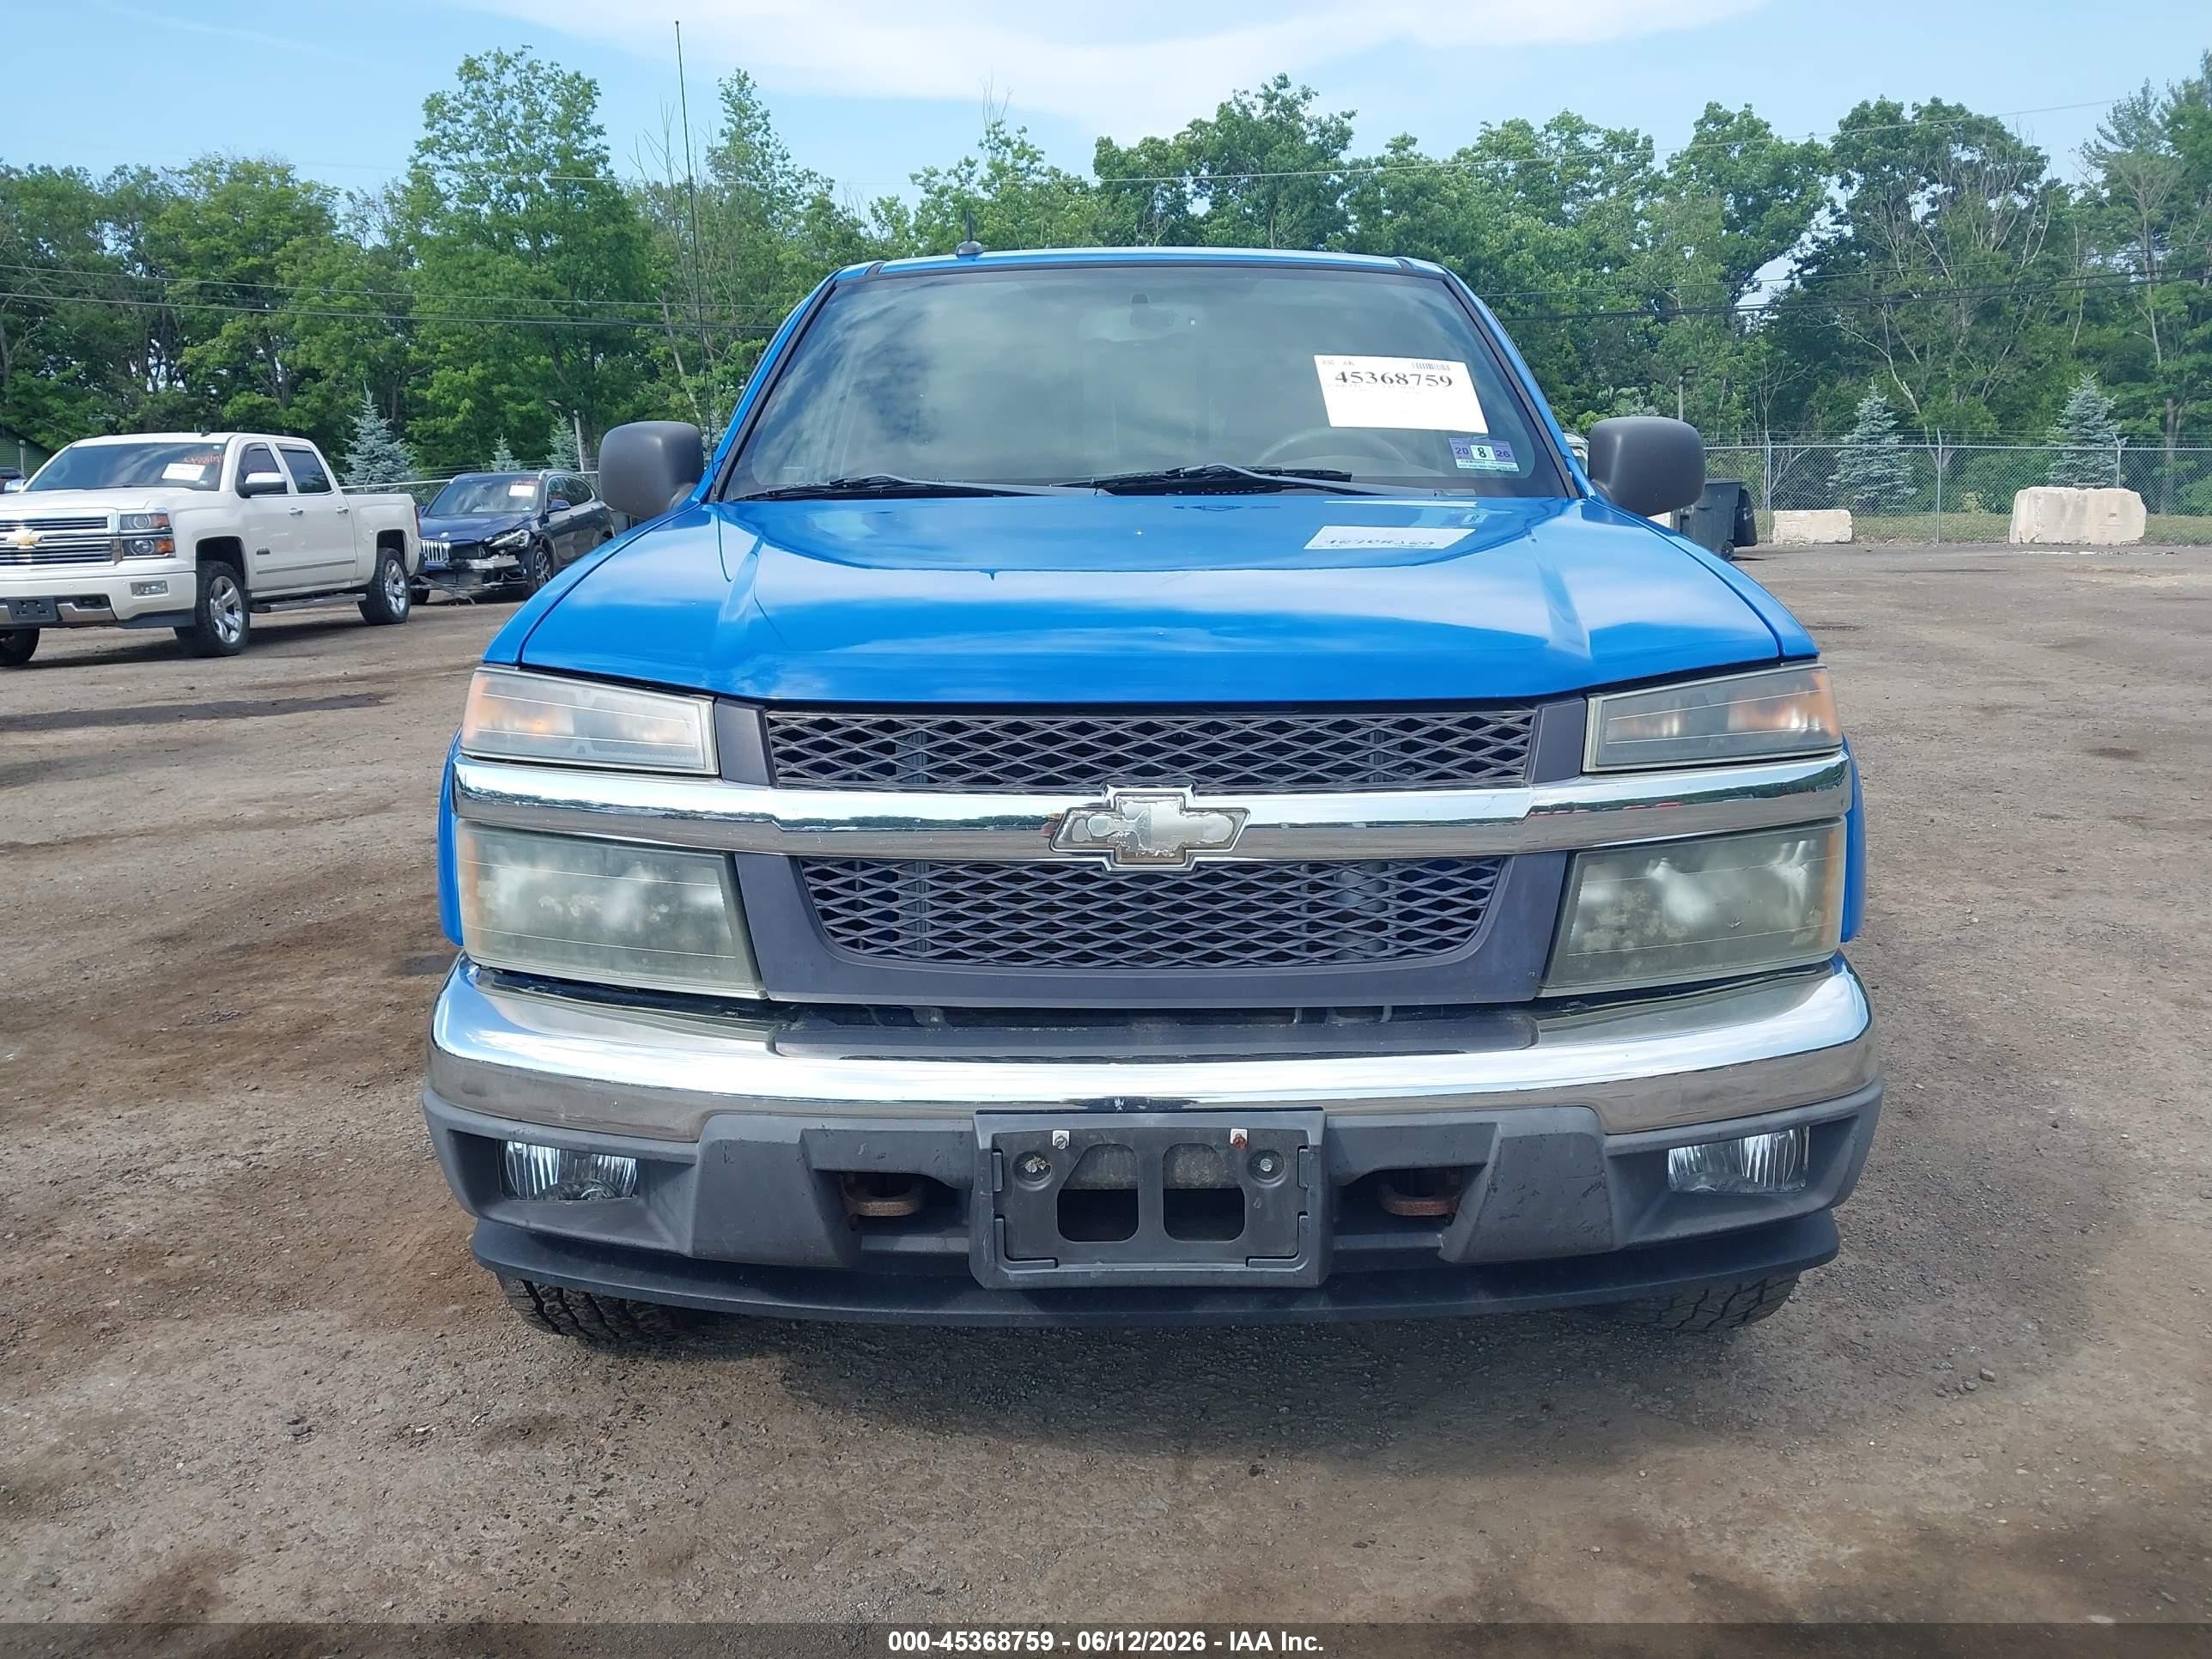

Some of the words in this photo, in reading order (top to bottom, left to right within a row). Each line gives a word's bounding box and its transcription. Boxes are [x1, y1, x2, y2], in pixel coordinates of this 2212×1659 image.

[1334, 371, 1453, 388] 45368759
[1455, 447, 1469, 455] 20
[1477, 447, 1487, 459] 8
[1496, 449, 1511, 458] 26
